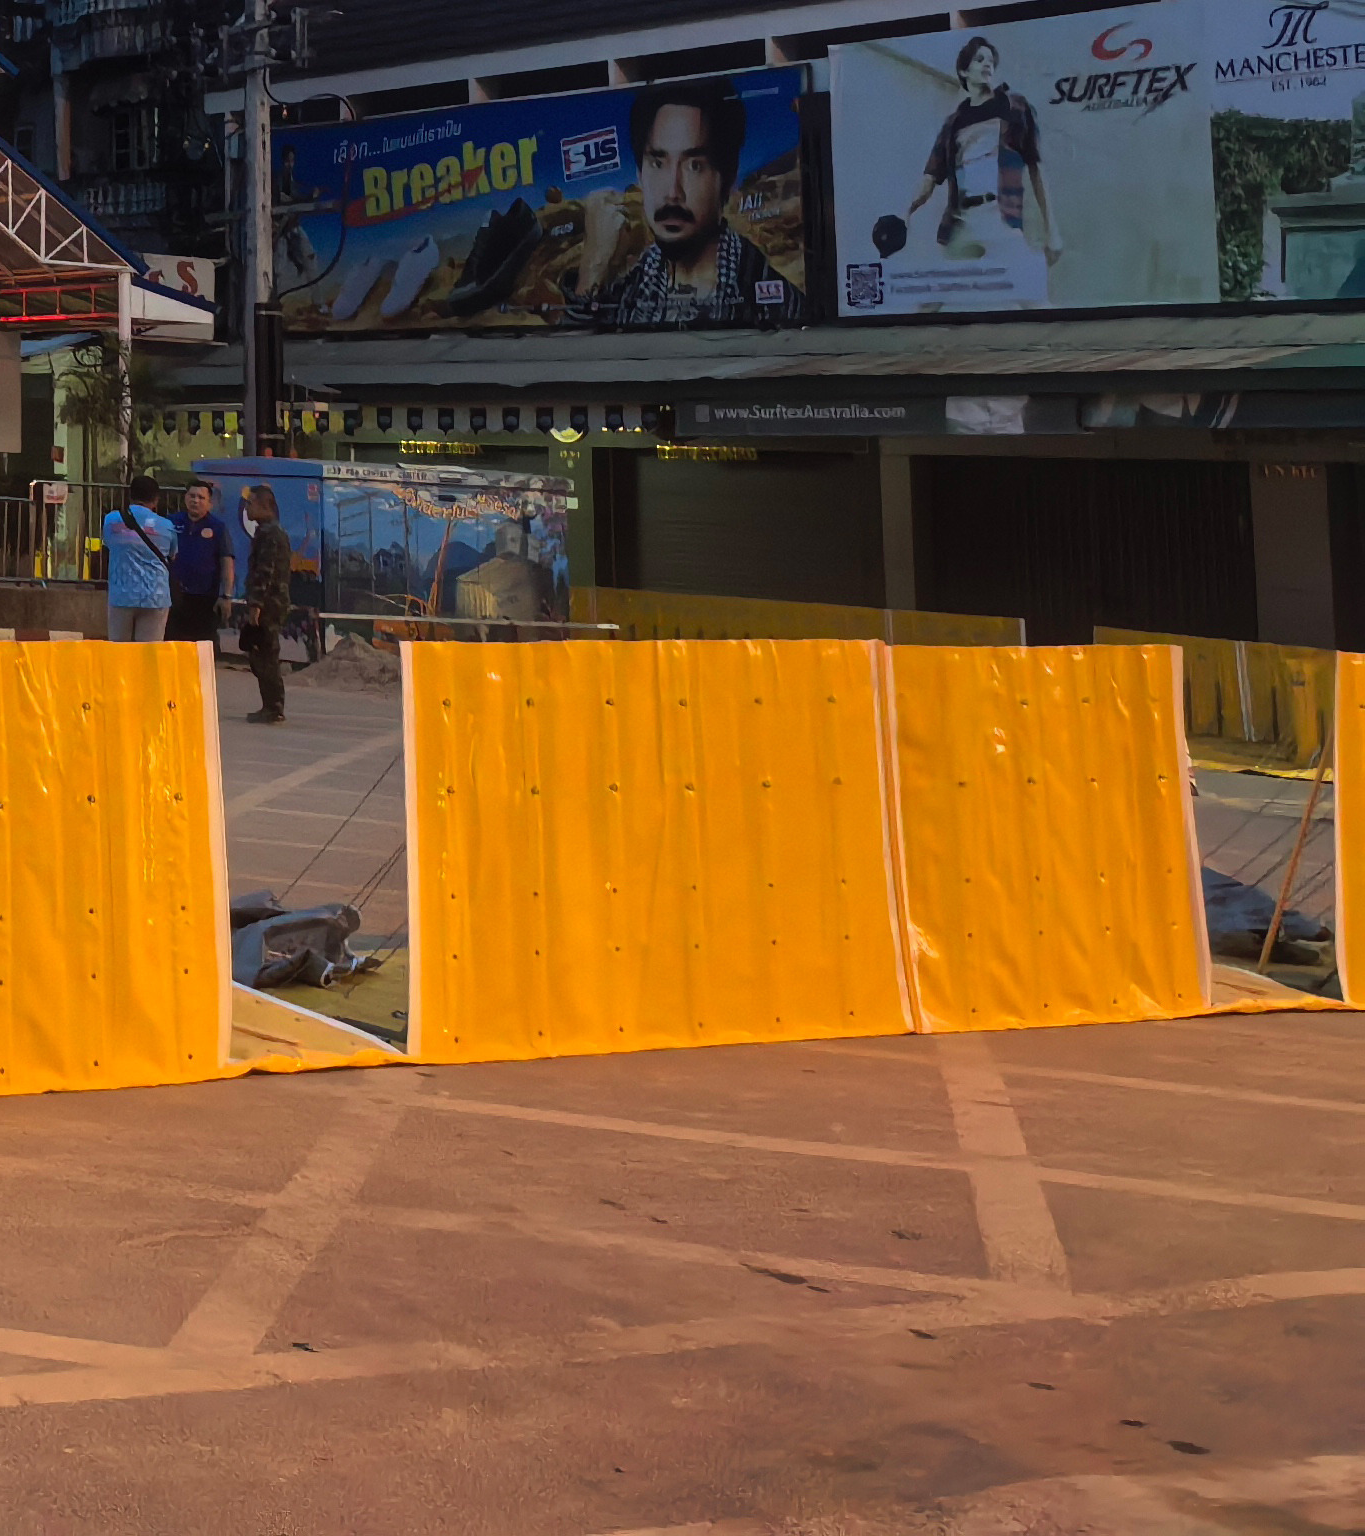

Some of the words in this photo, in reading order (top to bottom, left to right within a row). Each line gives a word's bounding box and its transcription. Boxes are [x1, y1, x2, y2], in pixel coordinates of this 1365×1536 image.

[1049, 62, 1198, 107] SURFTEX
[362, 133, 539, 219] Breaker
[714, 403, 907, 421] www.SurftexAustralia.com
